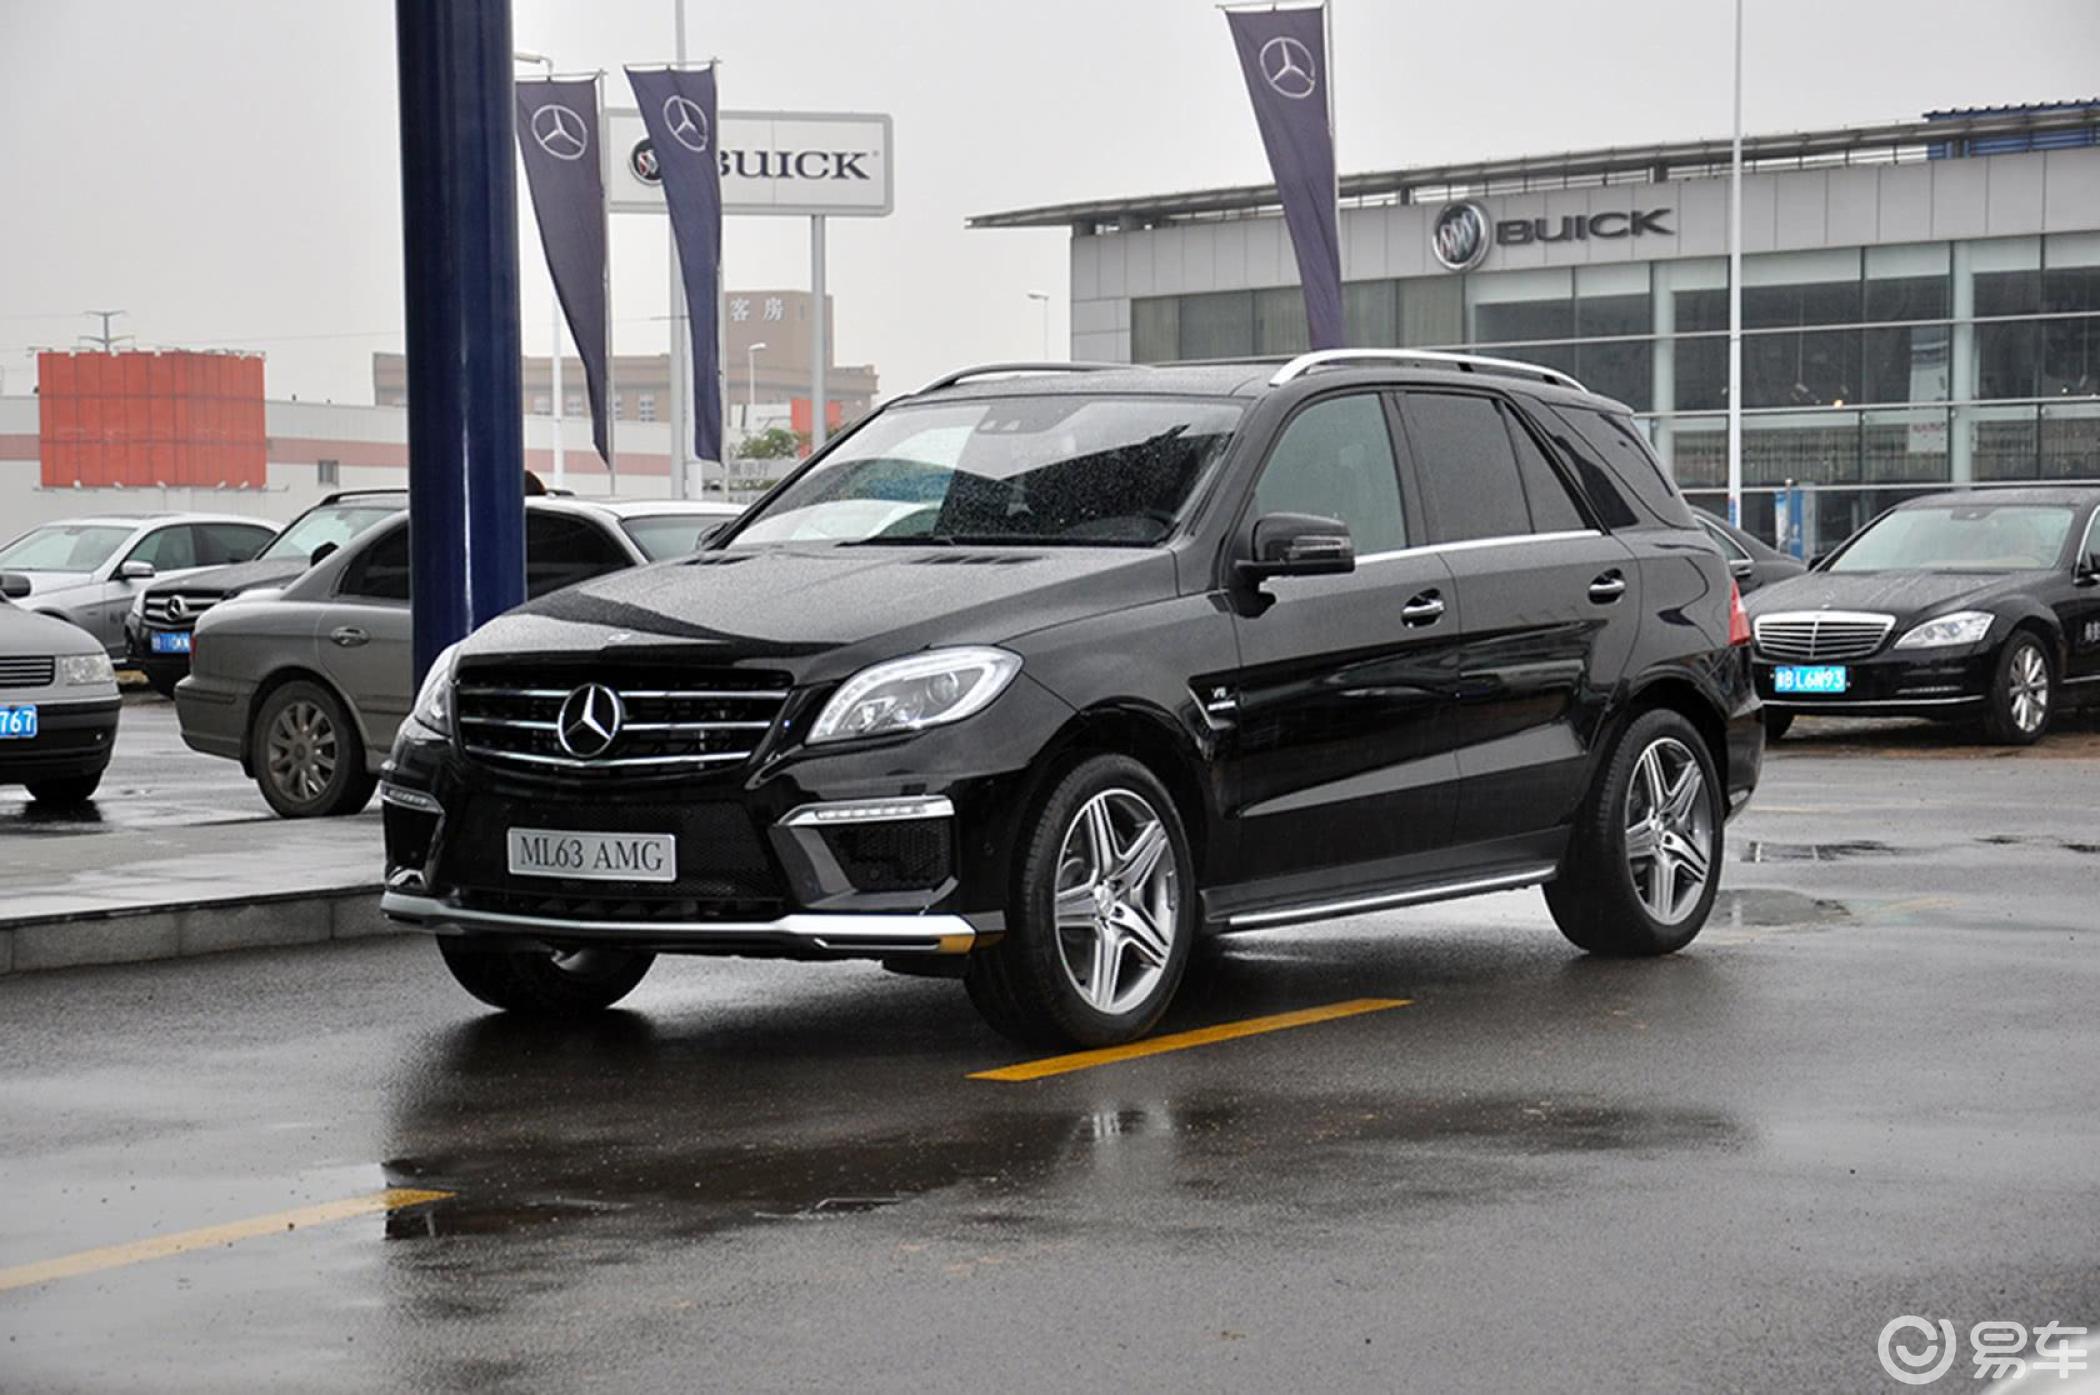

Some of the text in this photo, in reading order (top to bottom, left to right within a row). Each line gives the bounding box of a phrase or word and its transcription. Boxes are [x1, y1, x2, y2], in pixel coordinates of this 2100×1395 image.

[1495, 208, 1676, 247] BUICK
[519, 835, 665, 872] ML63 AMG
